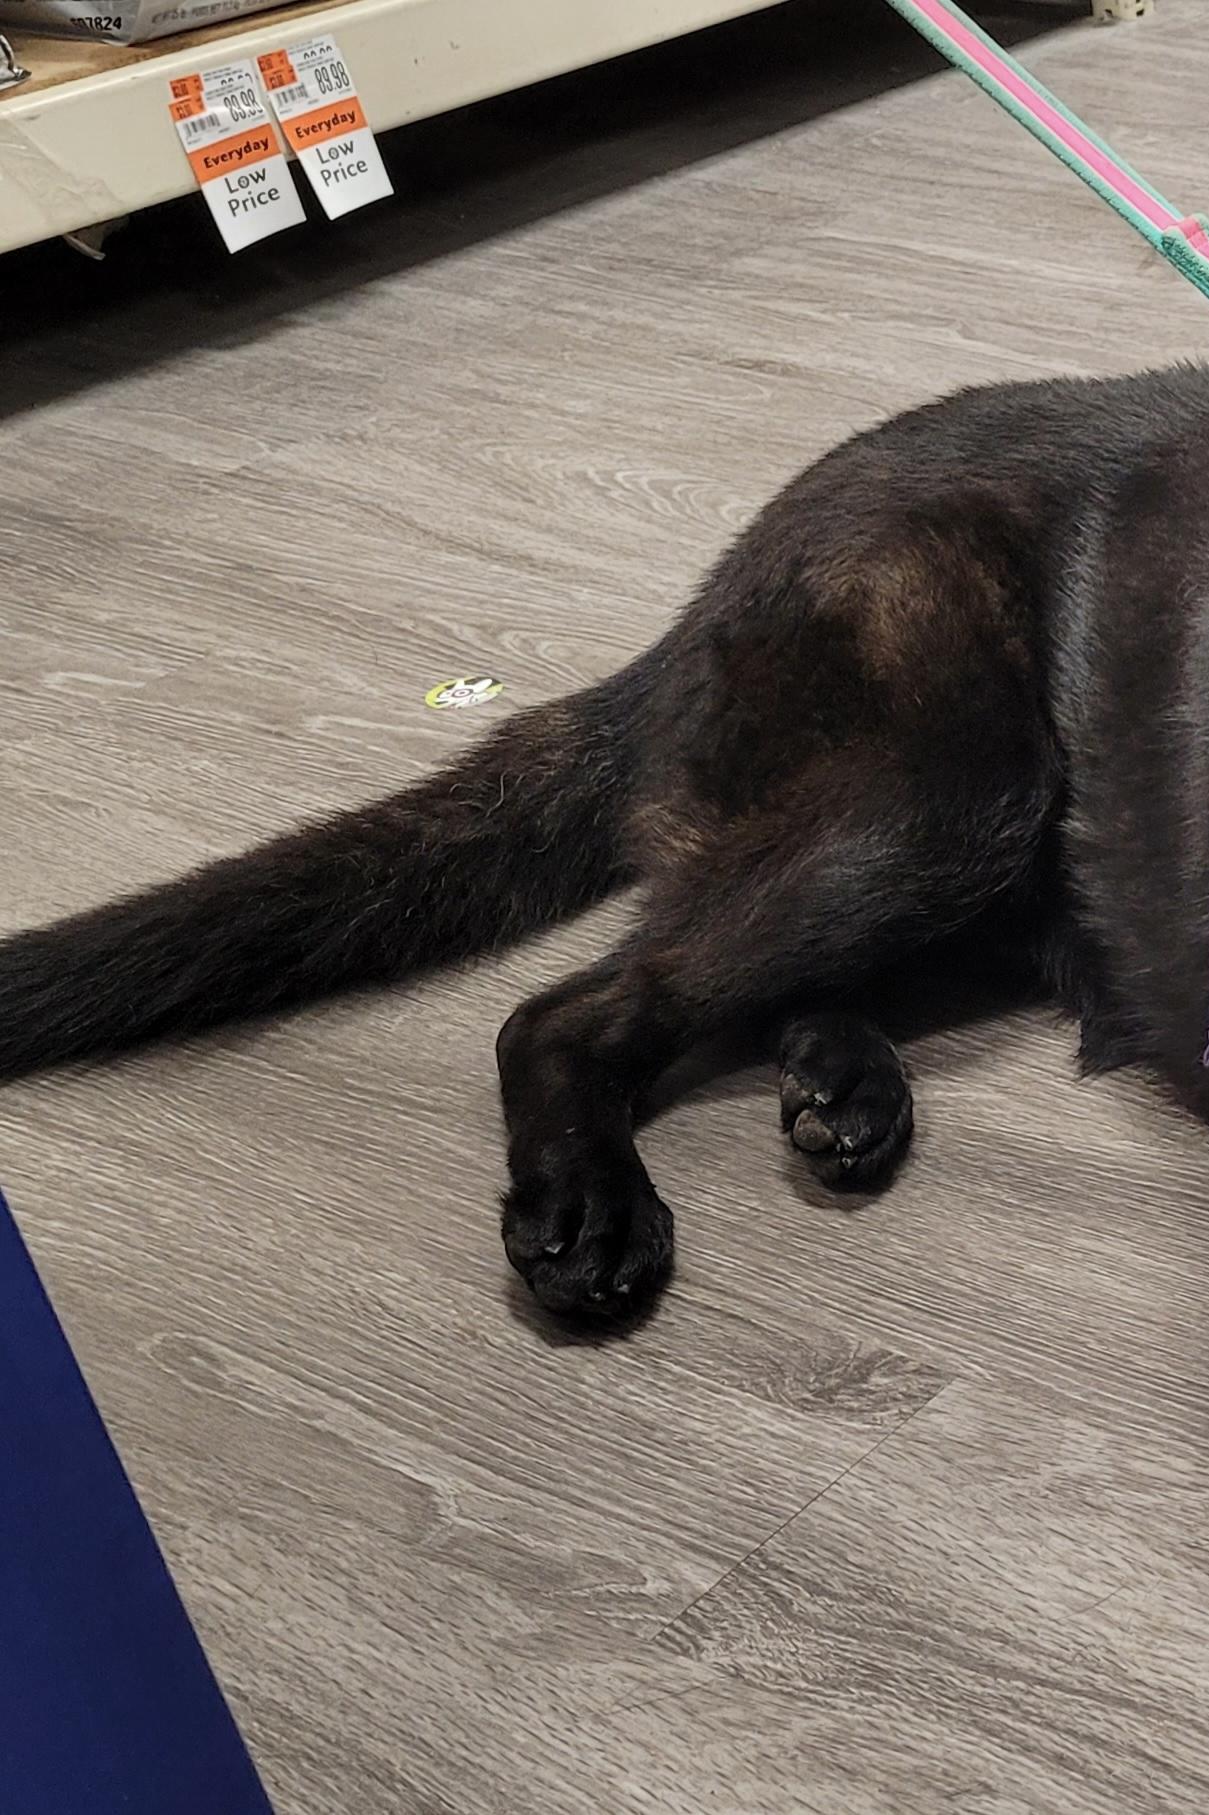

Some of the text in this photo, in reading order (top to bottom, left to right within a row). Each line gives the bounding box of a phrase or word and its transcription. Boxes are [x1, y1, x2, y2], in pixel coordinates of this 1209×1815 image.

[314, 60, 350, 95] 89.98
[295, 109, 356, 139] Everyday
[203, 136, 269, 169] Everyday
[315, 140, 355, 164] Low
[224, 167, 267, 195] Low
[320, 160, 368, 187] Price
[228, 187, 281, 217] Price
